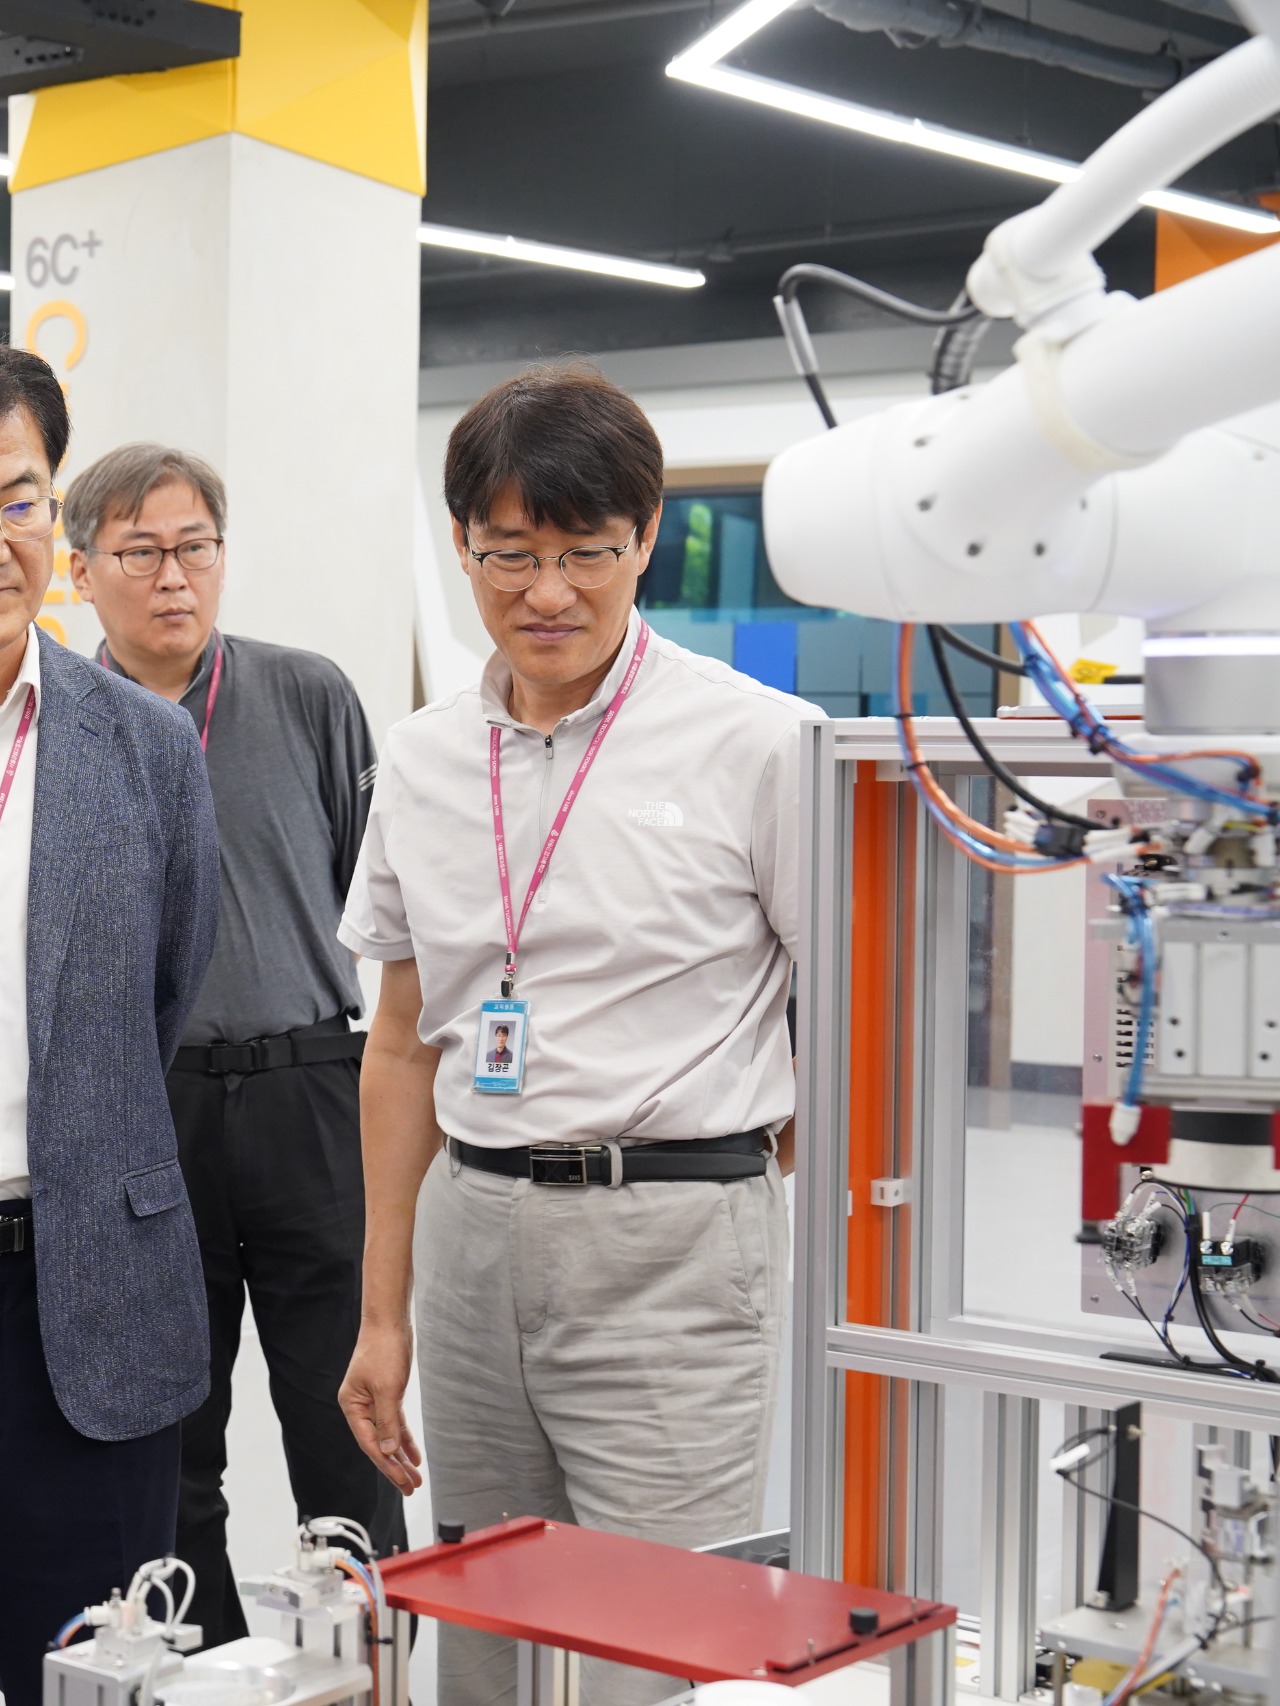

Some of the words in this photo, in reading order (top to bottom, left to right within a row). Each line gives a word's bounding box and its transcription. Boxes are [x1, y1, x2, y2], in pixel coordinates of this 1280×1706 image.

[26, 229, 102, 288] 6C+
[604, 710, 615, 725] SEOUL
[579, 755, 591, 774] SCHOOL
[566, 789, 575, 801] since
[645, 801, 665, 810] THE
[628, 809, 664, 818] NORTH
[638, 818, 664, 826] FACE
